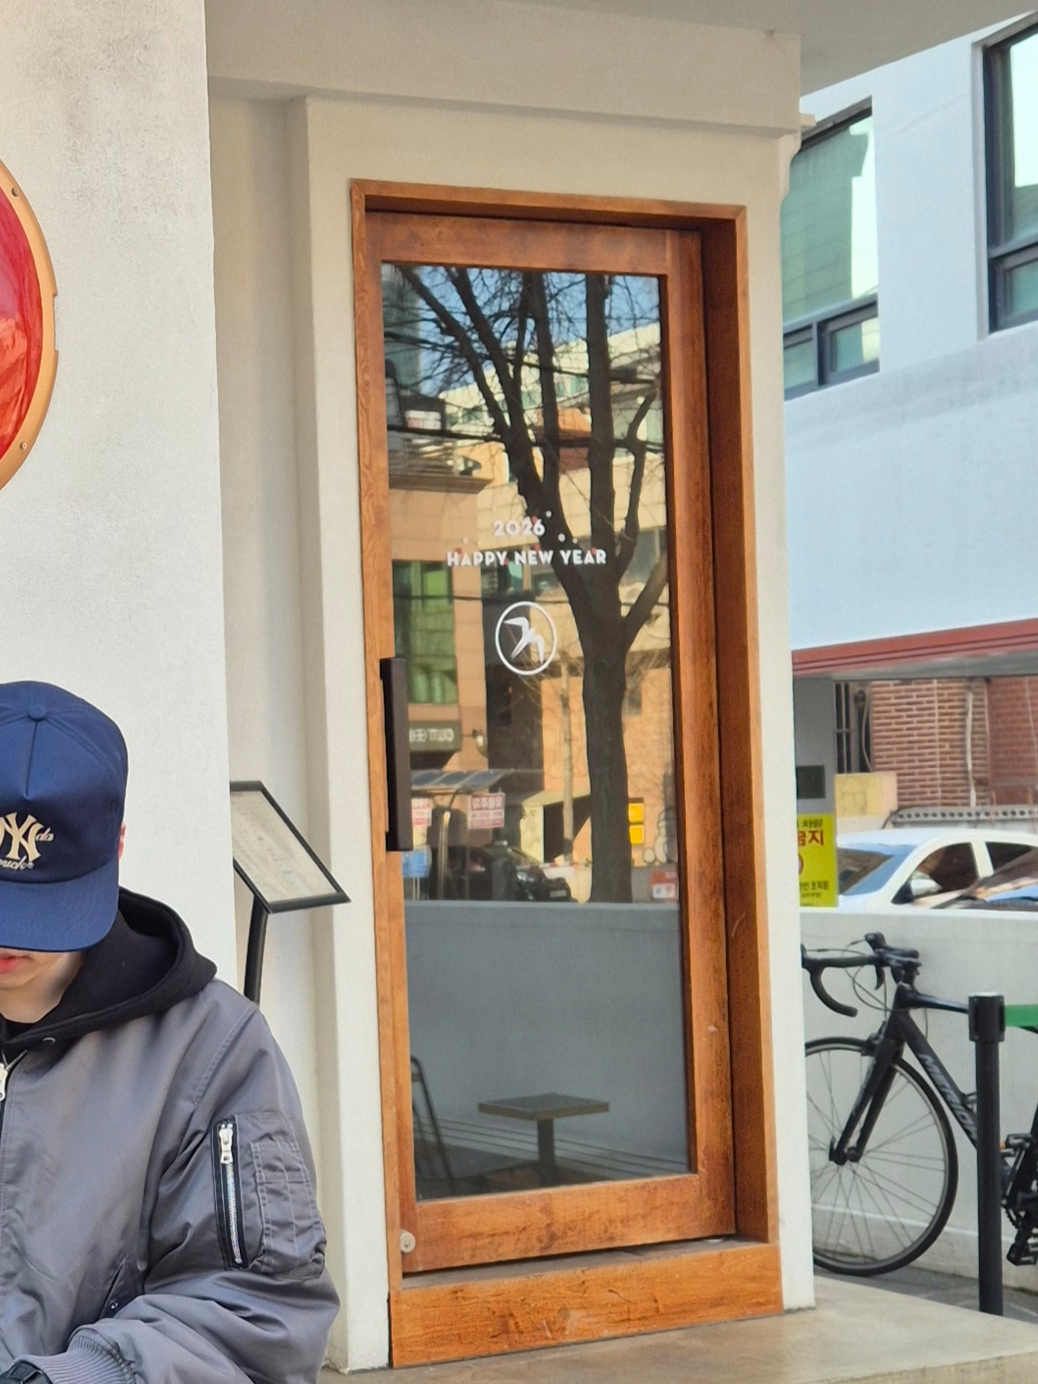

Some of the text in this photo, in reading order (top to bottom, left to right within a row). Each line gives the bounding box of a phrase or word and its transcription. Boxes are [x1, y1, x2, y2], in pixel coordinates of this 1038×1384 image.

[493, 517, 546, 537] 2026
[447, 549, 607, 567] HAPPY NEW YEAR
